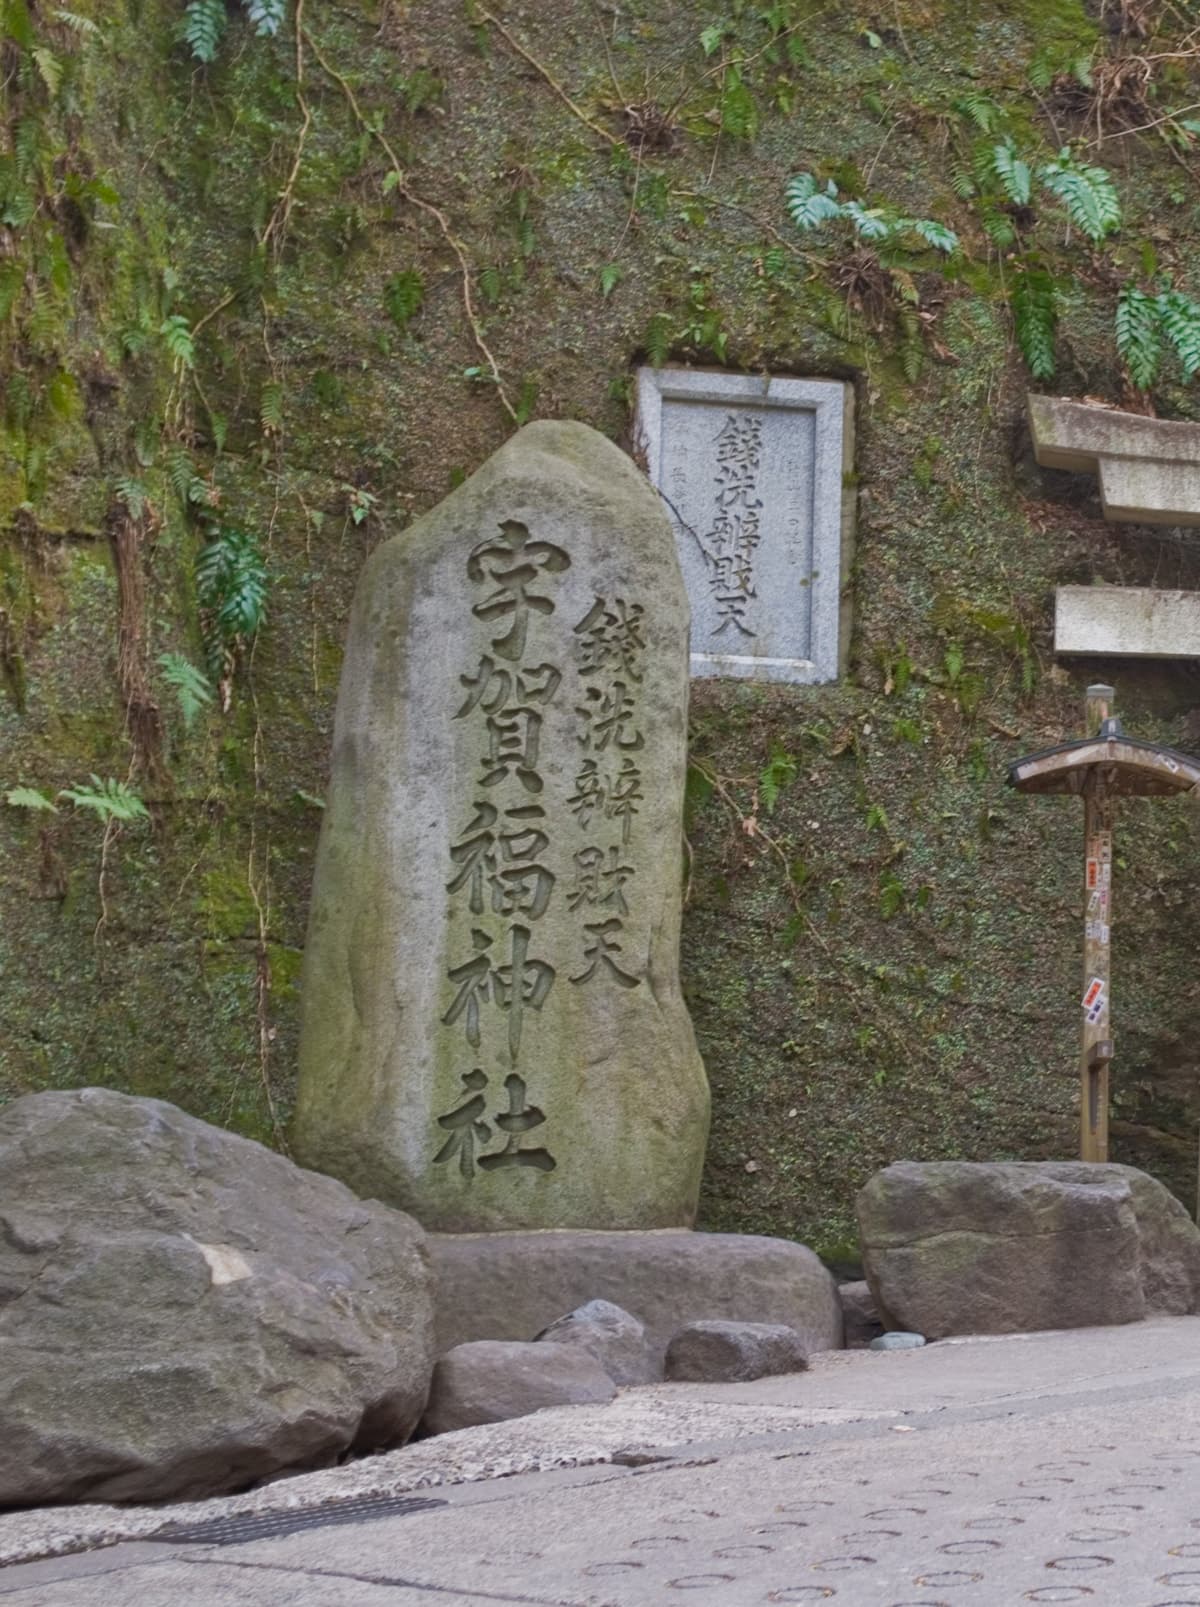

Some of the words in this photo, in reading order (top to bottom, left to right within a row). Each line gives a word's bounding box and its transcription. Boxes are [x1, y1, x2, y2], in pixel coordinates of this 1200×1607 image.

[433, 519, 571, 1180] 宇賀福神社
